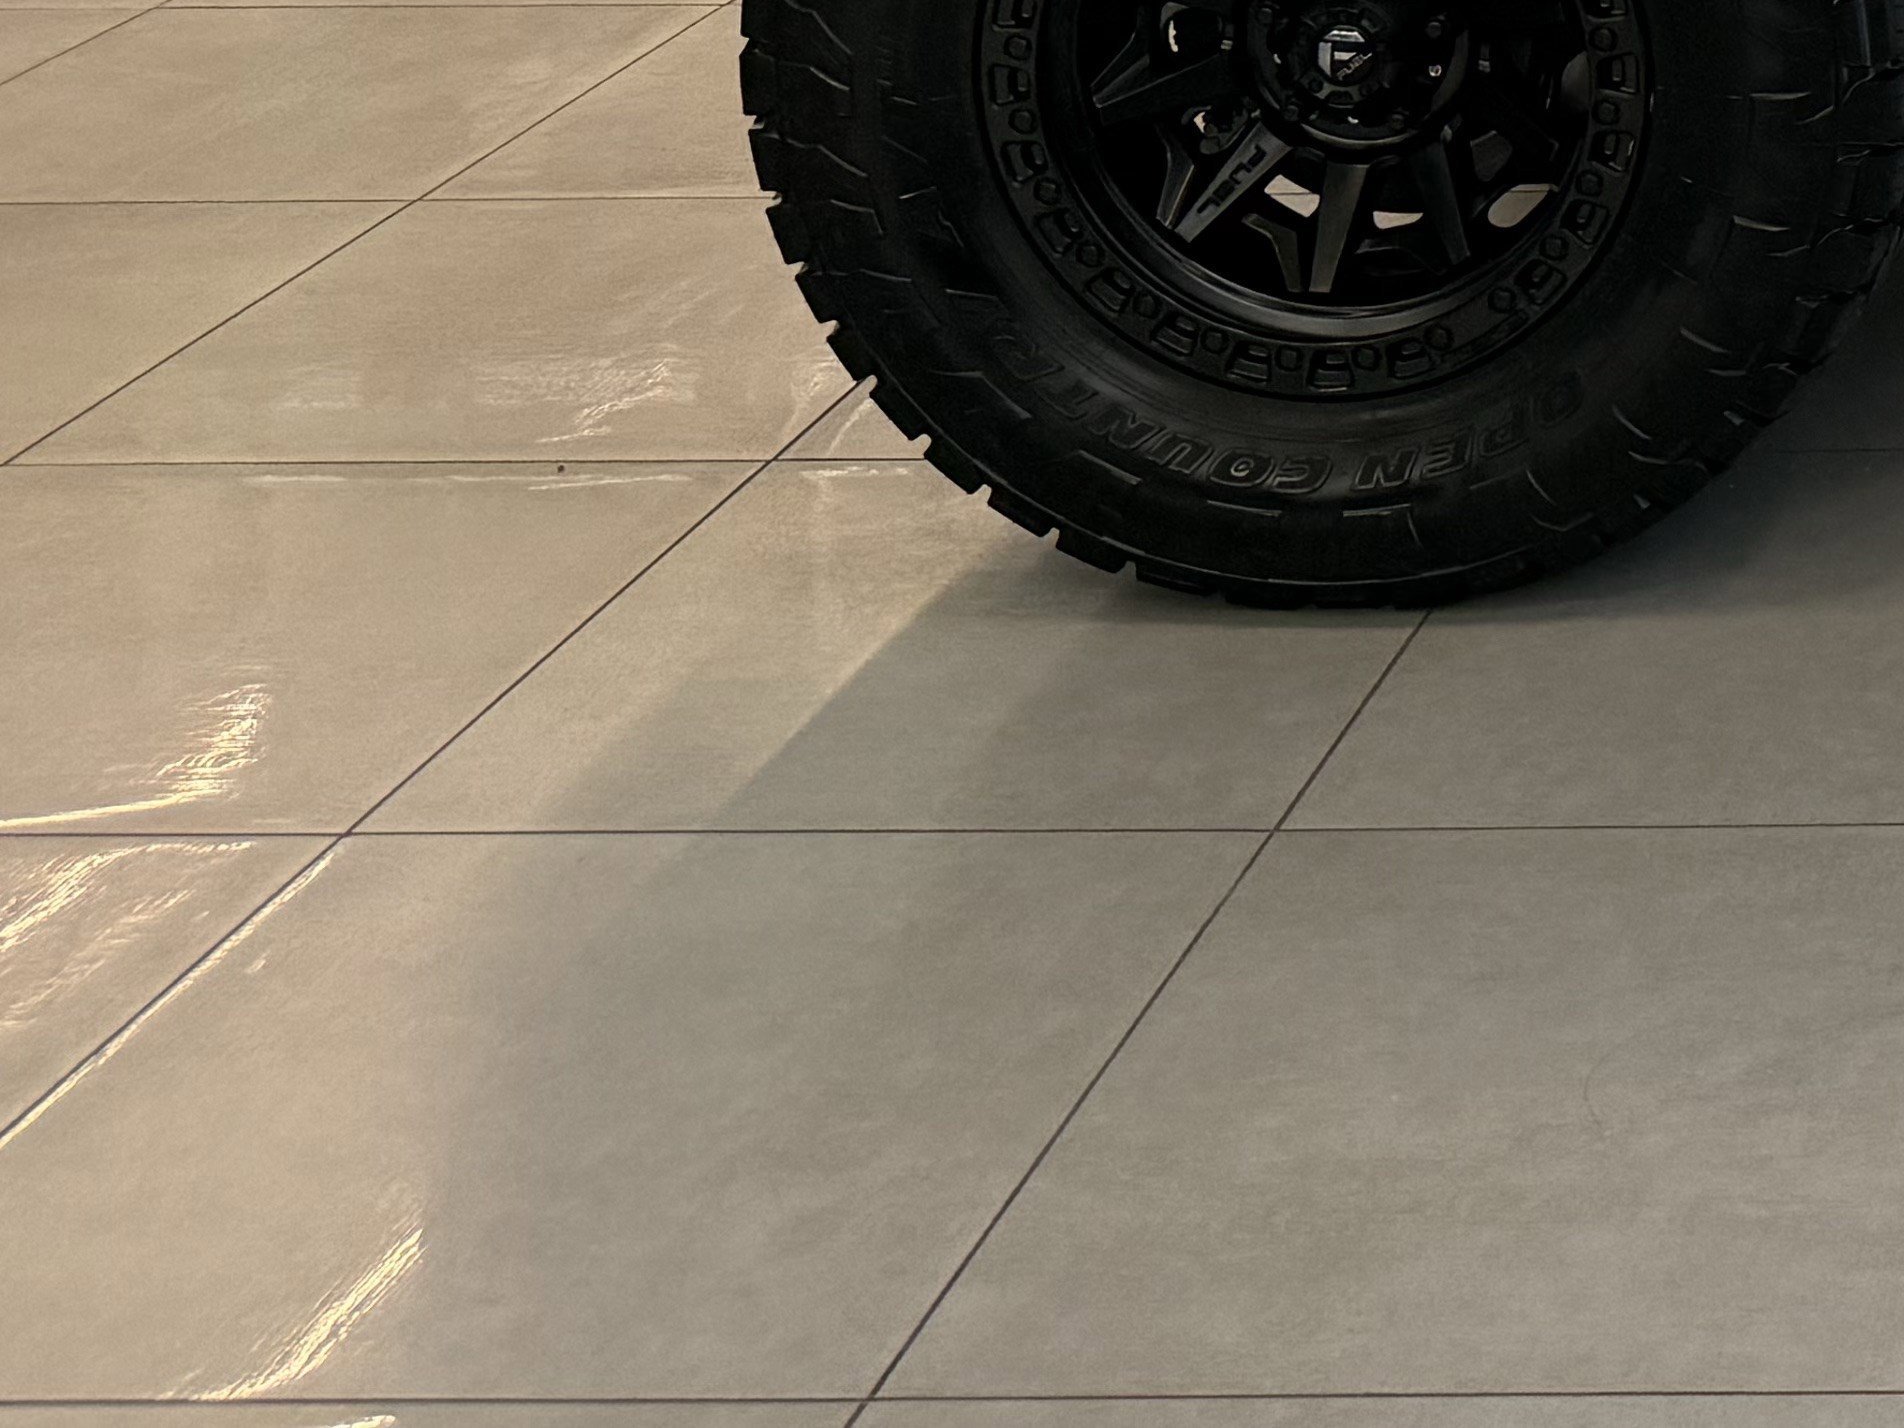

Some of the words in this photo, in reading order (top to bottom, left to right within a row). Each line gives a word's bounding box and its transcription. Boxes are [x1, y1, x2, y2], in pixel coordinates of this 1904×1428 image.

[1335, 51, 1373, 82] FUEL
[1196, 142, 1268, 214] FUEL
[1354, 370, 1582, 491] OPEN
